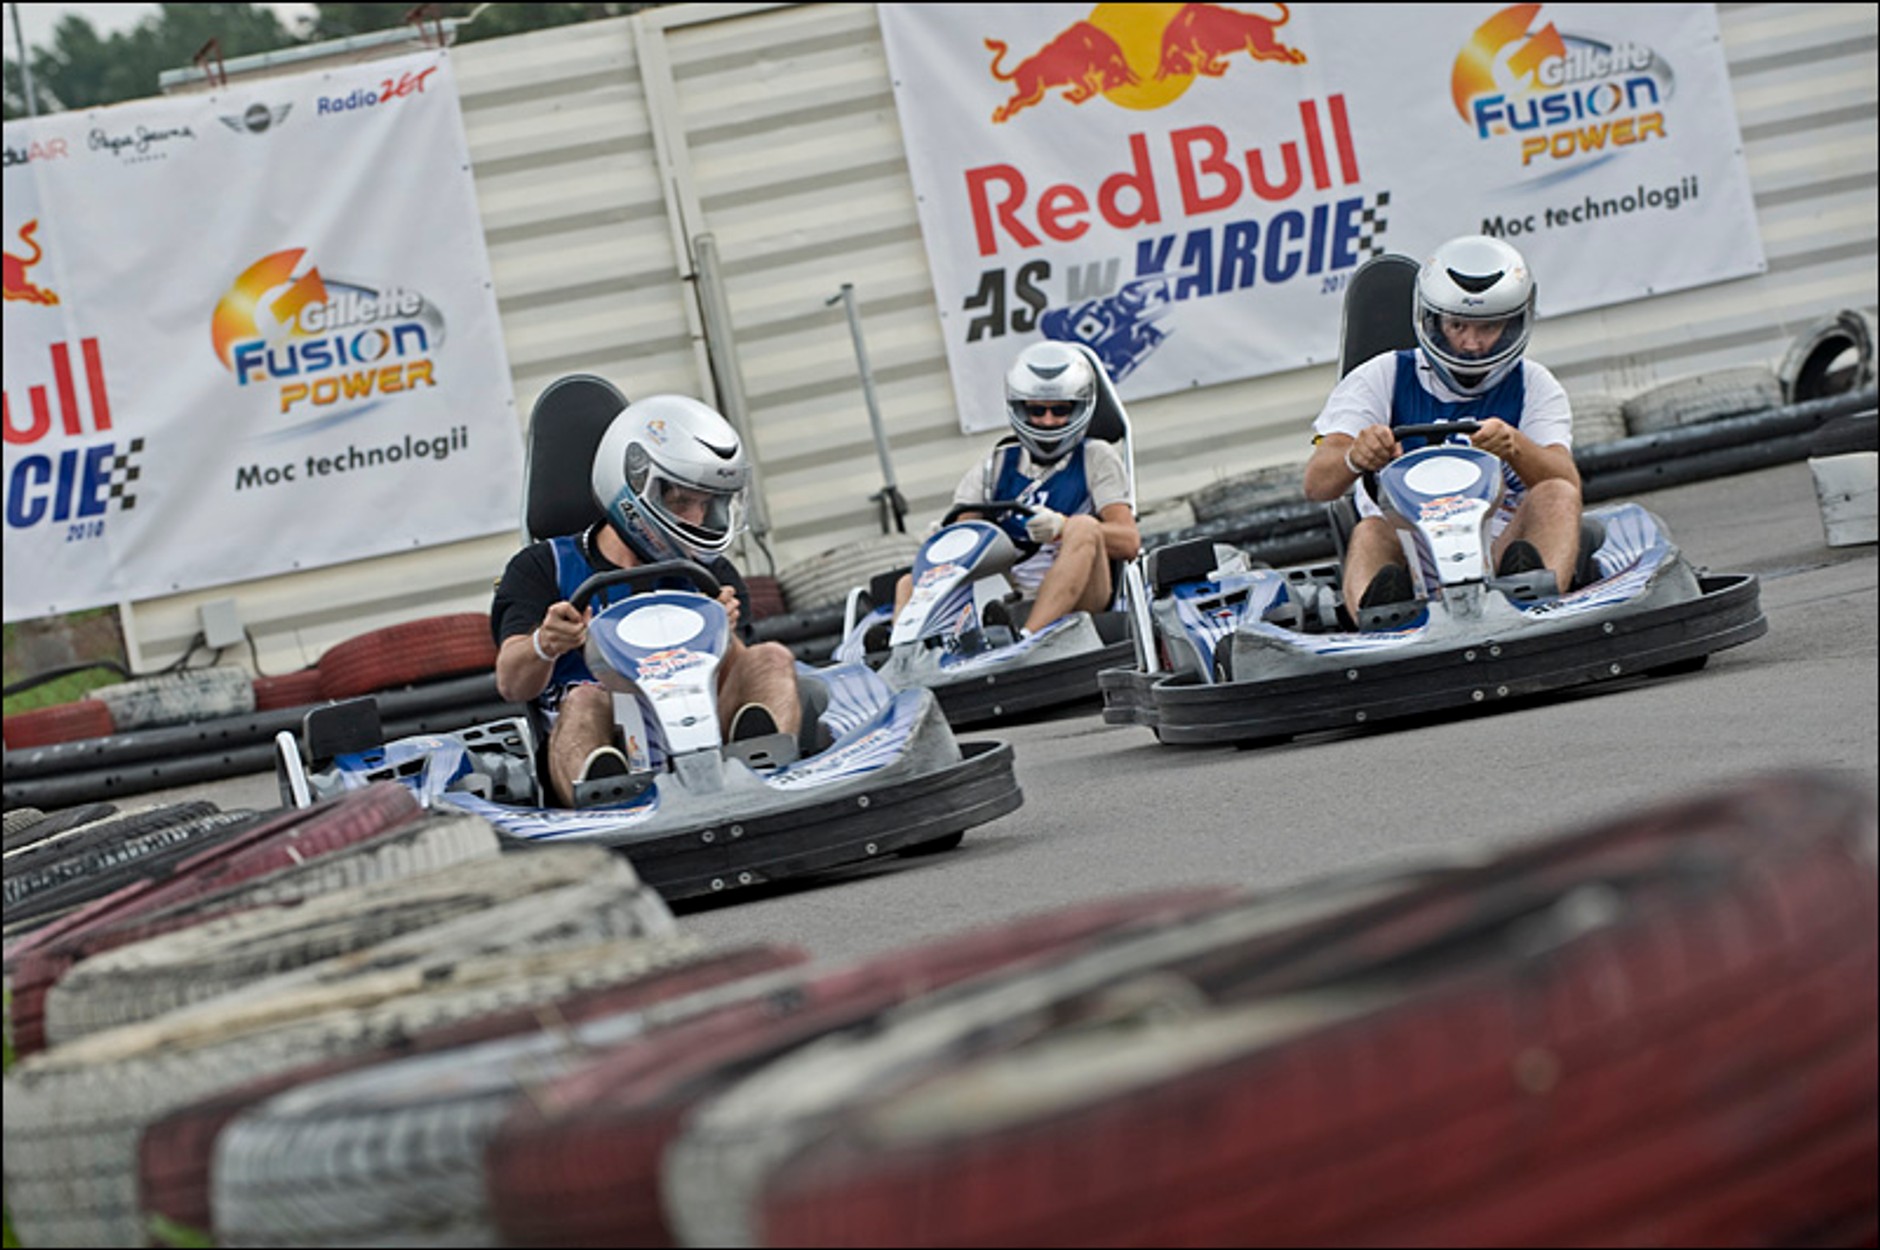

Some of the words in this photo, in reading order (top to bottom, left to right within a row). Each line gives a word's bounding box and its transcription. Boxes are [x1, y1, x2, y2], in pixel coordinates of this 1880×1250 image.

[318, 89, 378, 115] Radio
[379, 66, 437, 104] ZET
[1538, 44, 1652, 87] Gillette
[1521, 111, 1668, 166] POWER
[964, 132, 1163, 257] Red
[1169, 93, 1361, 217] Bull
[1480, 216, 1536, 240] Moc
[1544, 175, 1699, 228] technologii
[962, 259, 1051, 344] AS
[1134, 196, 1365, 302] KARCIE
[300, 287, 424, 334] Gillette
[279, 358, 437, 414] POWER
[235, 466, 296, 490] Moc
[305, 425, 469, 478] technologii
